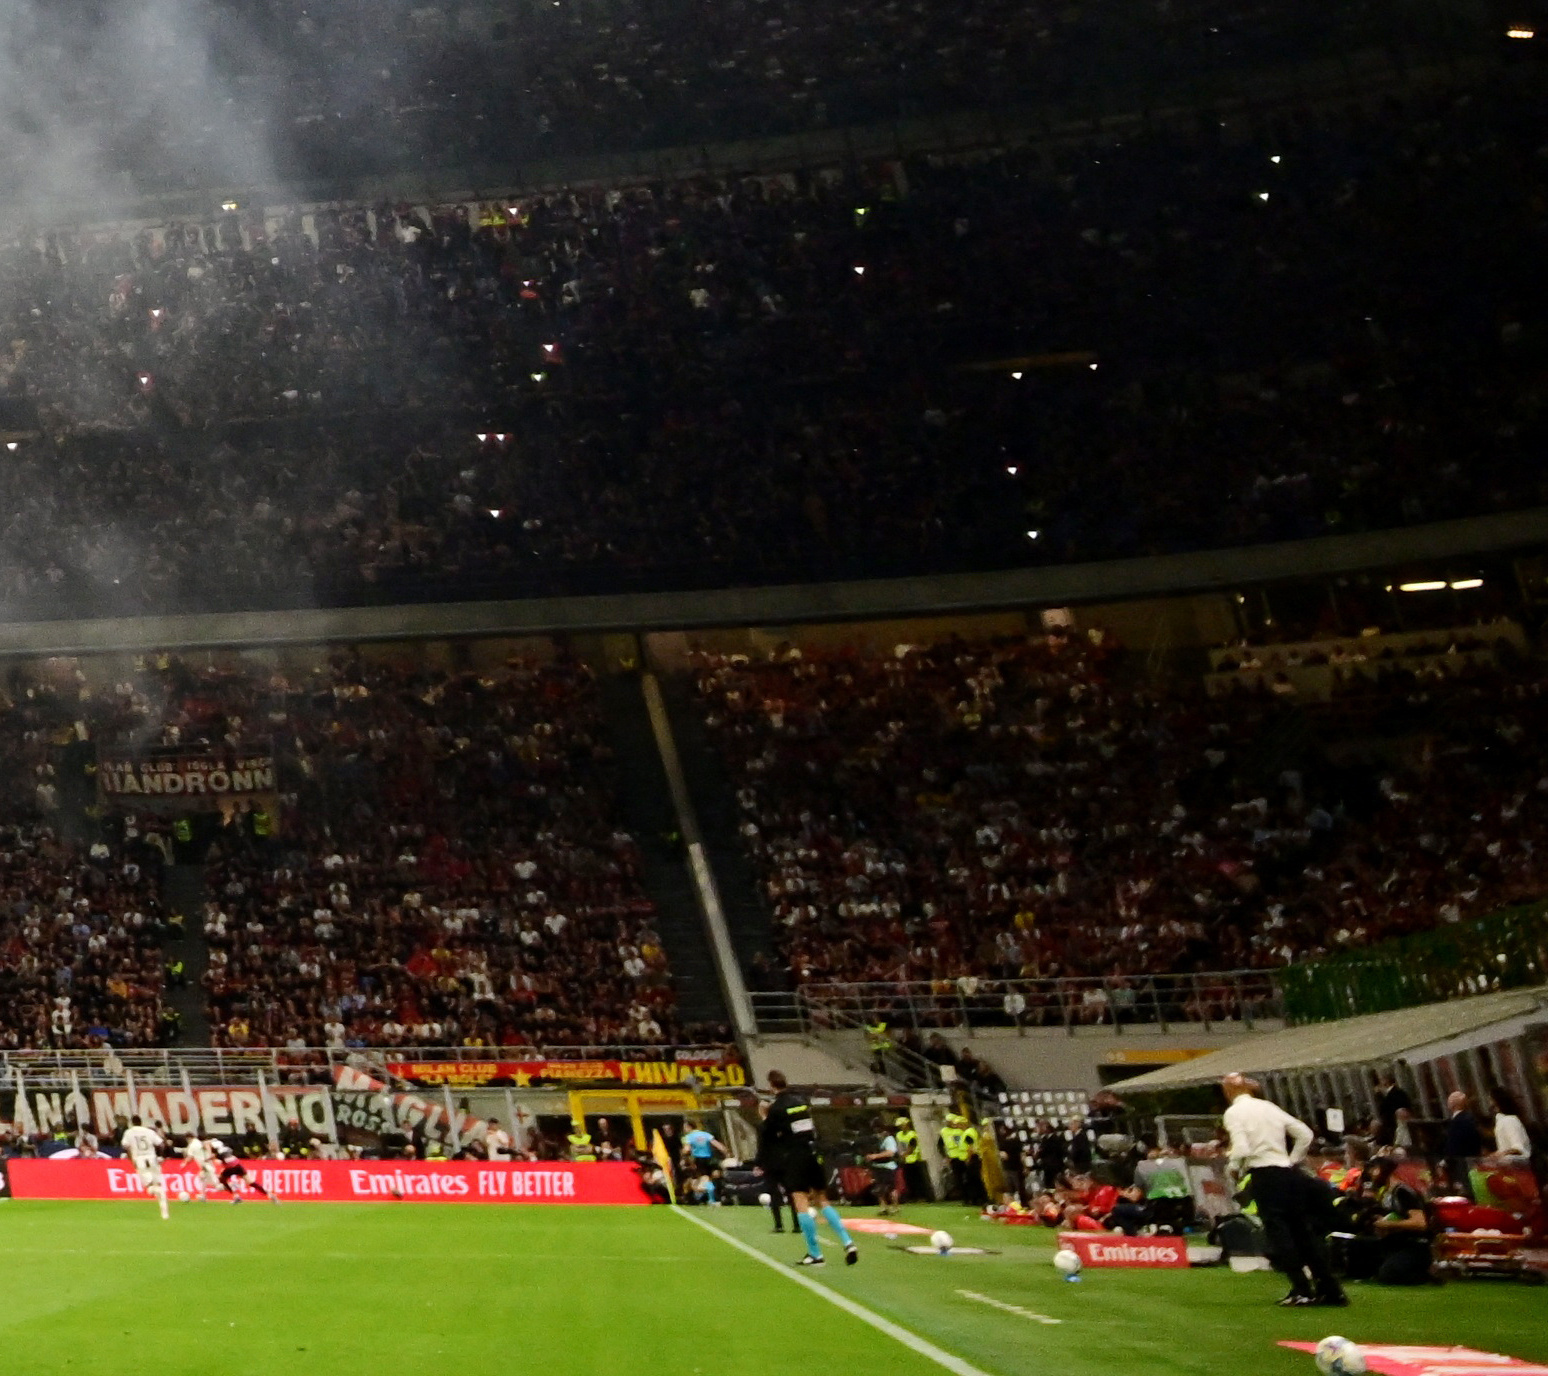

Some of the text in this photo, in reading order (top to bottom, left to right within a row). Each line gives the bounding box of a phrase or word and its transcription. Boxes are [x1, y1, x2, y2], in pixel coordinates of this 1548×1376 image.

[93, 1090, 334, 1136] MADERNO
[262, 1169, 323, 1194] BETTER
[348, 1168, 575, 1195] Emirates FLY BETTER
[1088, 1242, 1179, 1263] Emirates
